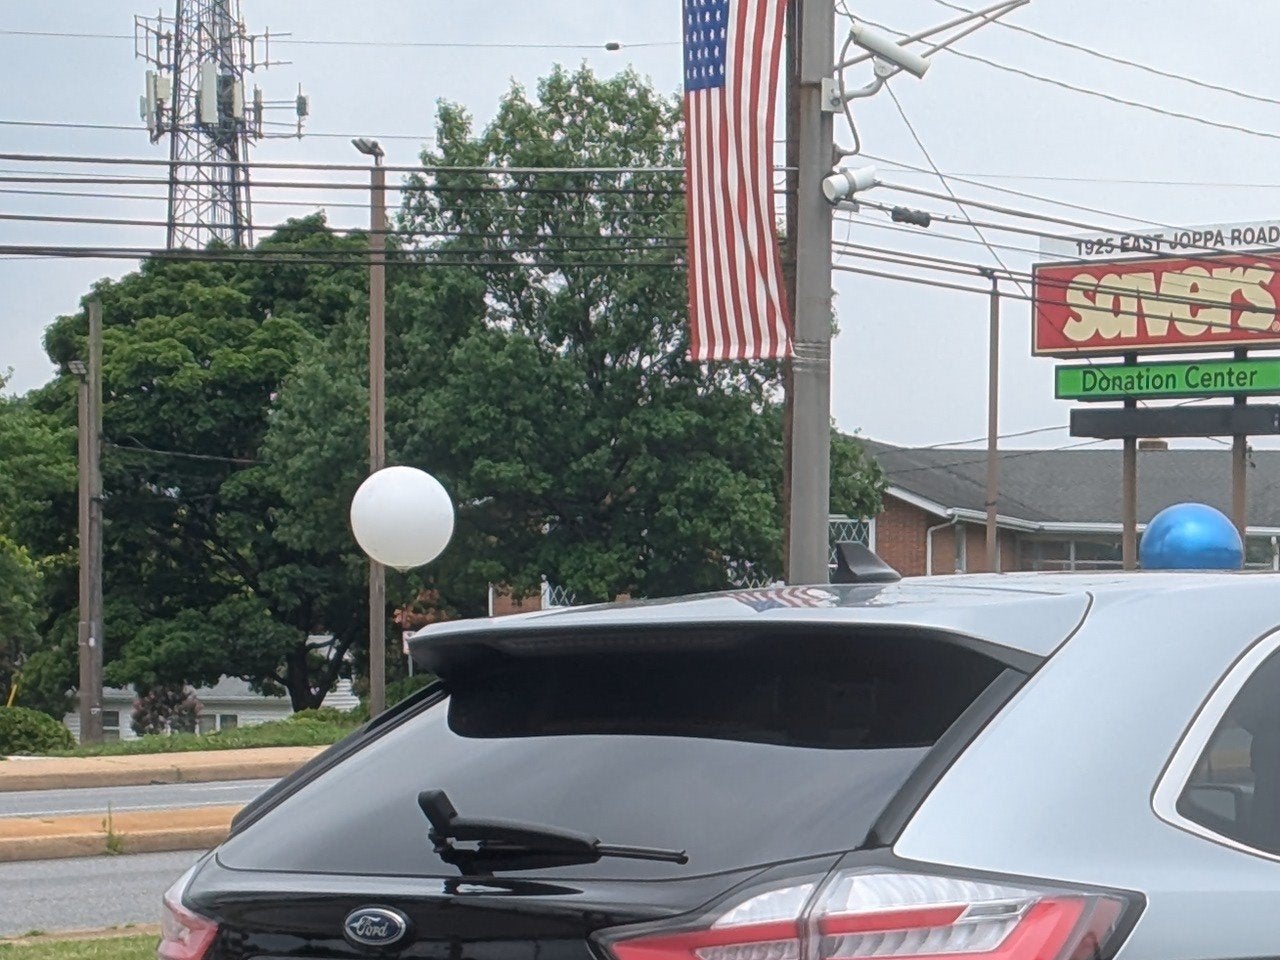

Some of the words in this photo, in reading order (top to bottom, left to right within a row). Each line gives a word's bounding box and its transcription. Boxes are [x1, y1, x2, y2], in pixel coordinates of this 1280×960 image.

[1076, 237, 1115, 256] 1925
[1120, 234, 1165, 252] EAST
[1169, 229, 1226, 249] JOPPA
[1230, 226, 1280, 246] ROAD
[1081, 368, 1177, 393] Donation
[1184, 365, 1258, 390] Center
[352, 915, 388, 938] Ford
